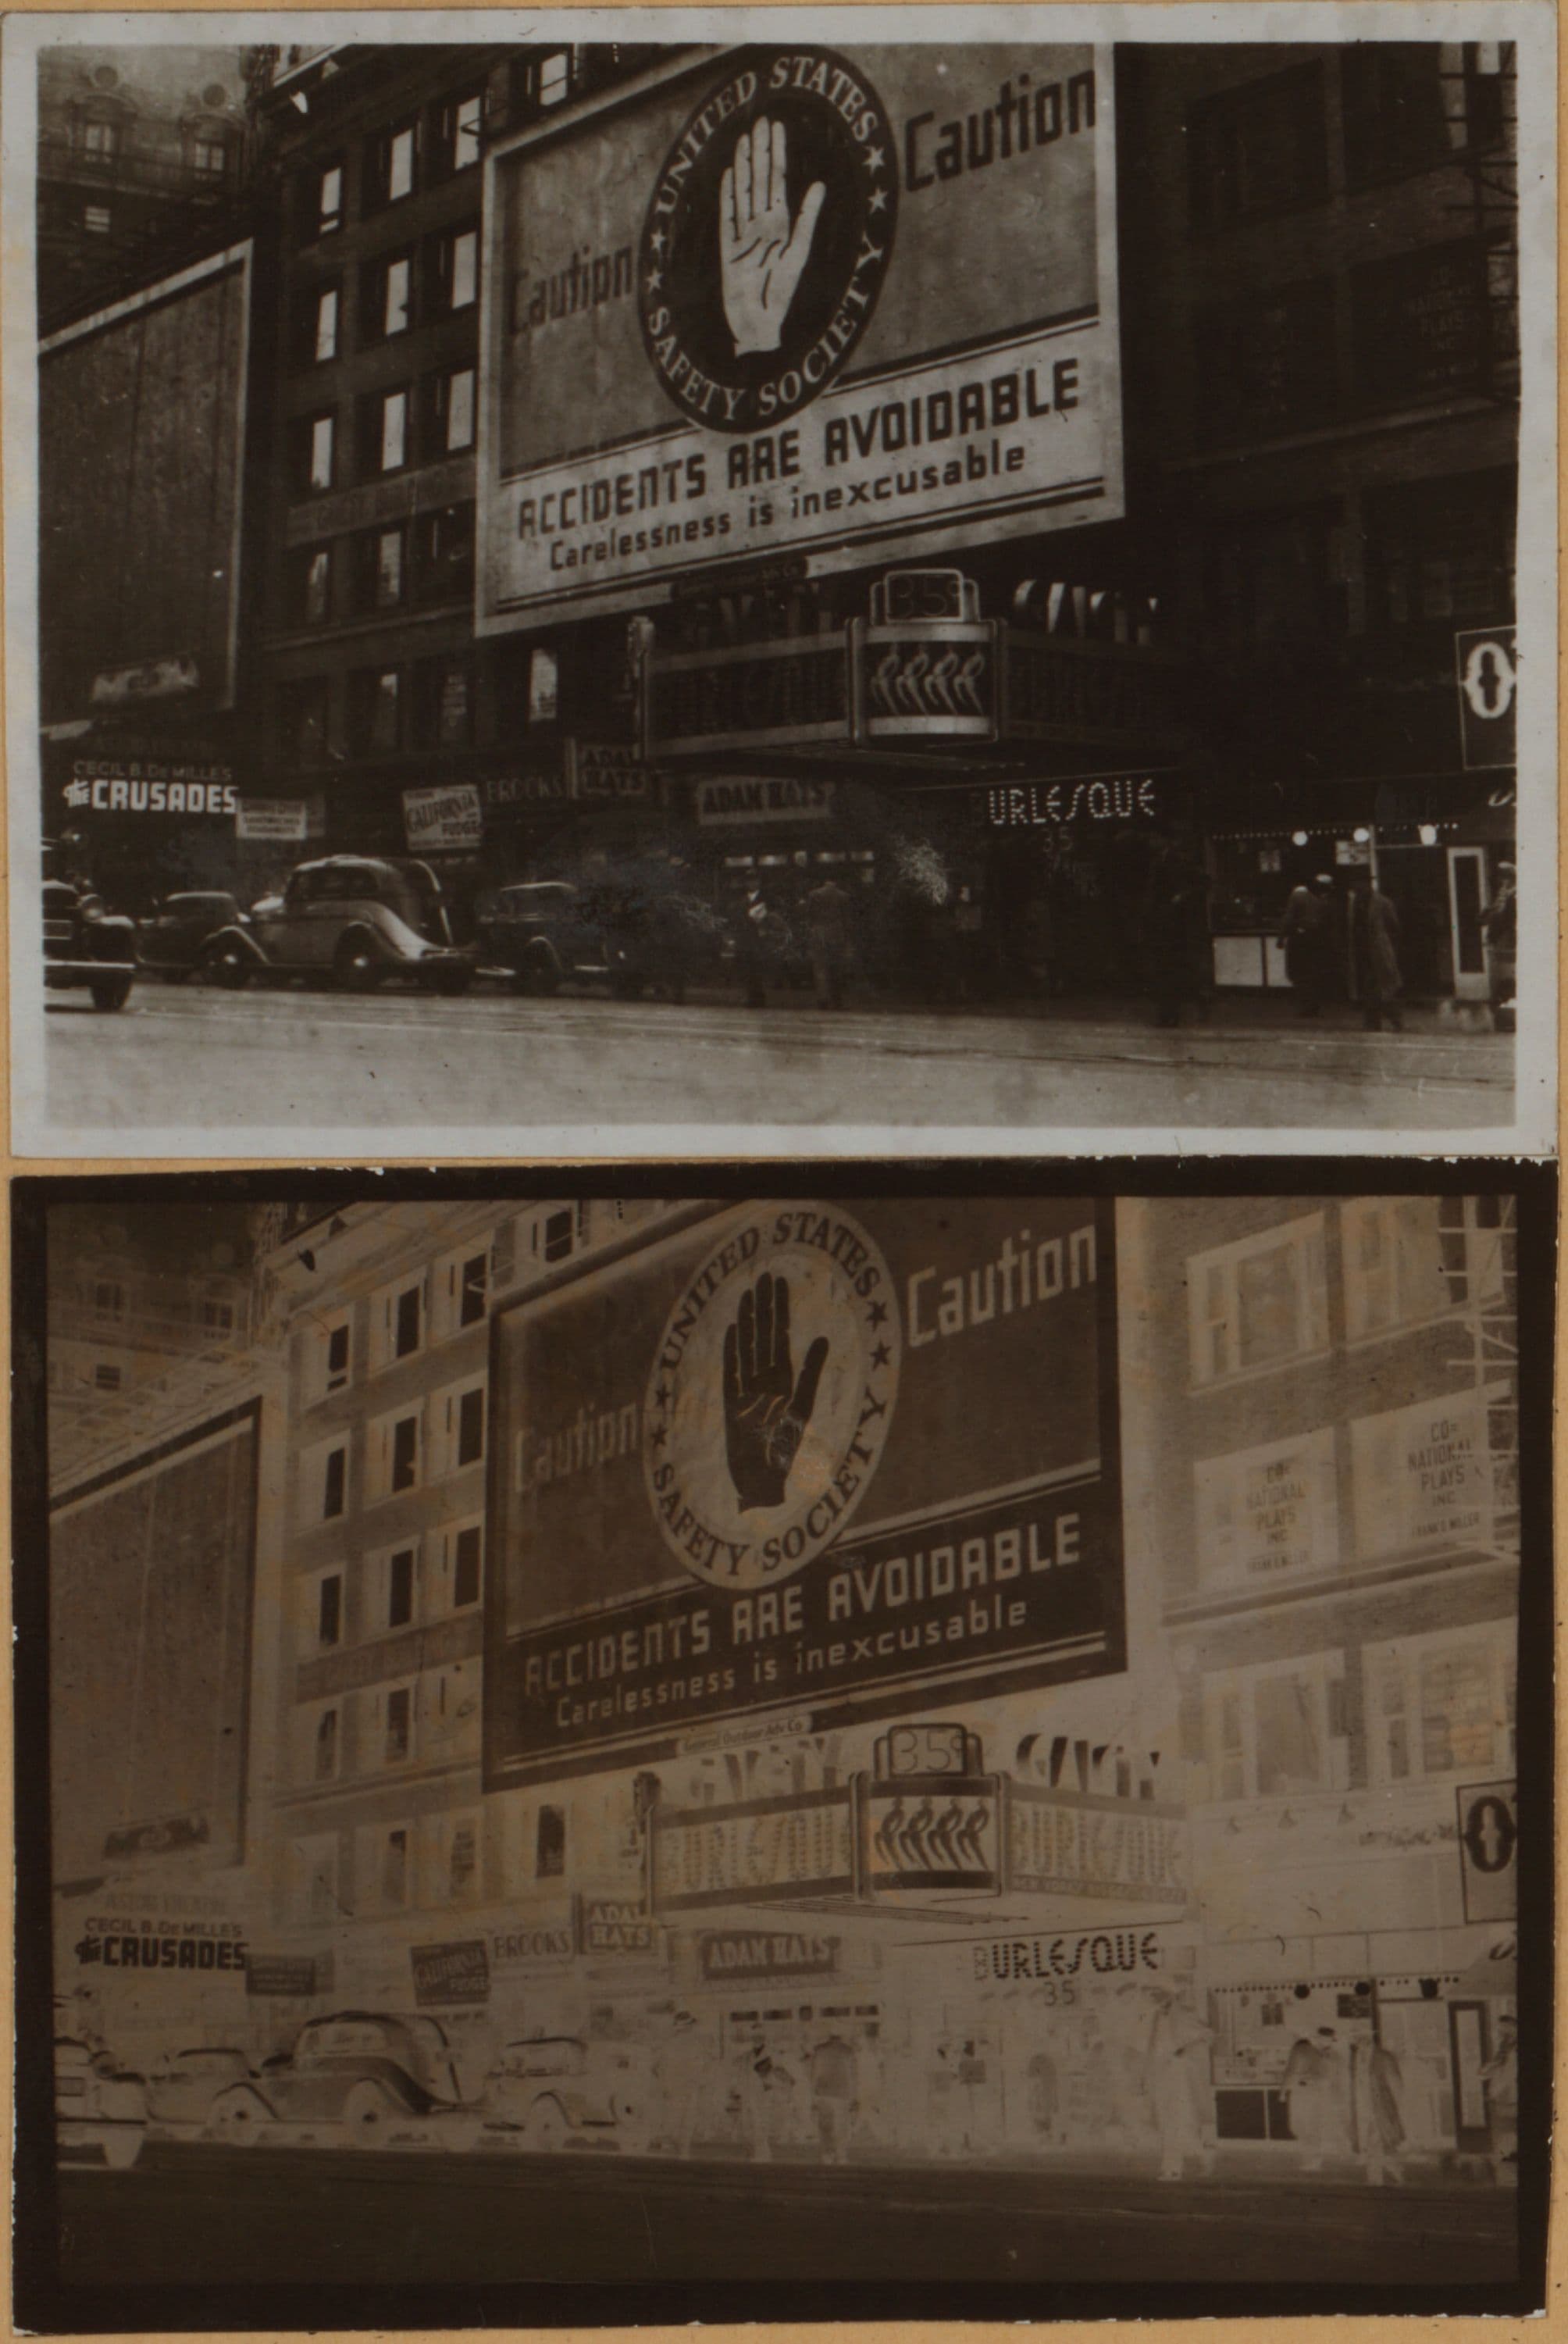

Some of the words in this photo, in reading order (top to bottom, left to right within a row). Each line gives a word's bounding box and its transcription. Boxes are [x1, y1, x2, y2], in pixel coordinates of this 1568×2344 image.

[655, 70, 757, 216] UNITED
[771, 55, 880, 143] STATES
[904, 70, 1096, 193] Caution
[510, 244, 634, 336] Caution
[647, 307, 747, 421] SAFETY
[757, 232, 884, 417] SOCIETY
[518, 454, 707, 540] ACCIDENTS
[727, 429, 800, 490] ARE
[825, 358, 1079, 466] AVOIDABLE
[551, 508, 731, 572] Carelessness
[747, 495, 774, 529] is
[791, 439, 1025, 519] inexcusable
[92, 779, 239, 813] CRUSADES
[663, 1226, 760, 1369] UNITED
[772, 1211, 882, 1299] STATES
[907, 1226, 1098, 1348] Caution
[515, 1400, 638, 1493] Caution
[653, 1463, 751, 1576] SAFETY
[761, 1387, 887, 1573] SOCIETY
[1421, 1464, 1465, 1493] PLAYS
[525, 1610, 711, 1696] ACCIDENTS
[732, 1586, 804, 1646] ARE
[829, 1512, 1082, 1623] AVOIDABLE
[555, 1664, 736, 1728] Carelessness
[753, 1650, 778, 1683] is
[795, 1596, 1028, 1675] inexcusable
[84, 1918, 137, 1934] CECIL
[103, 1936, 250, 1971] CRUSADES
[590, 1925, 650, 1946] HATS
[709, 1939, 768, 1969] ADAM
[772, 1935, 830, 1964] HATS
